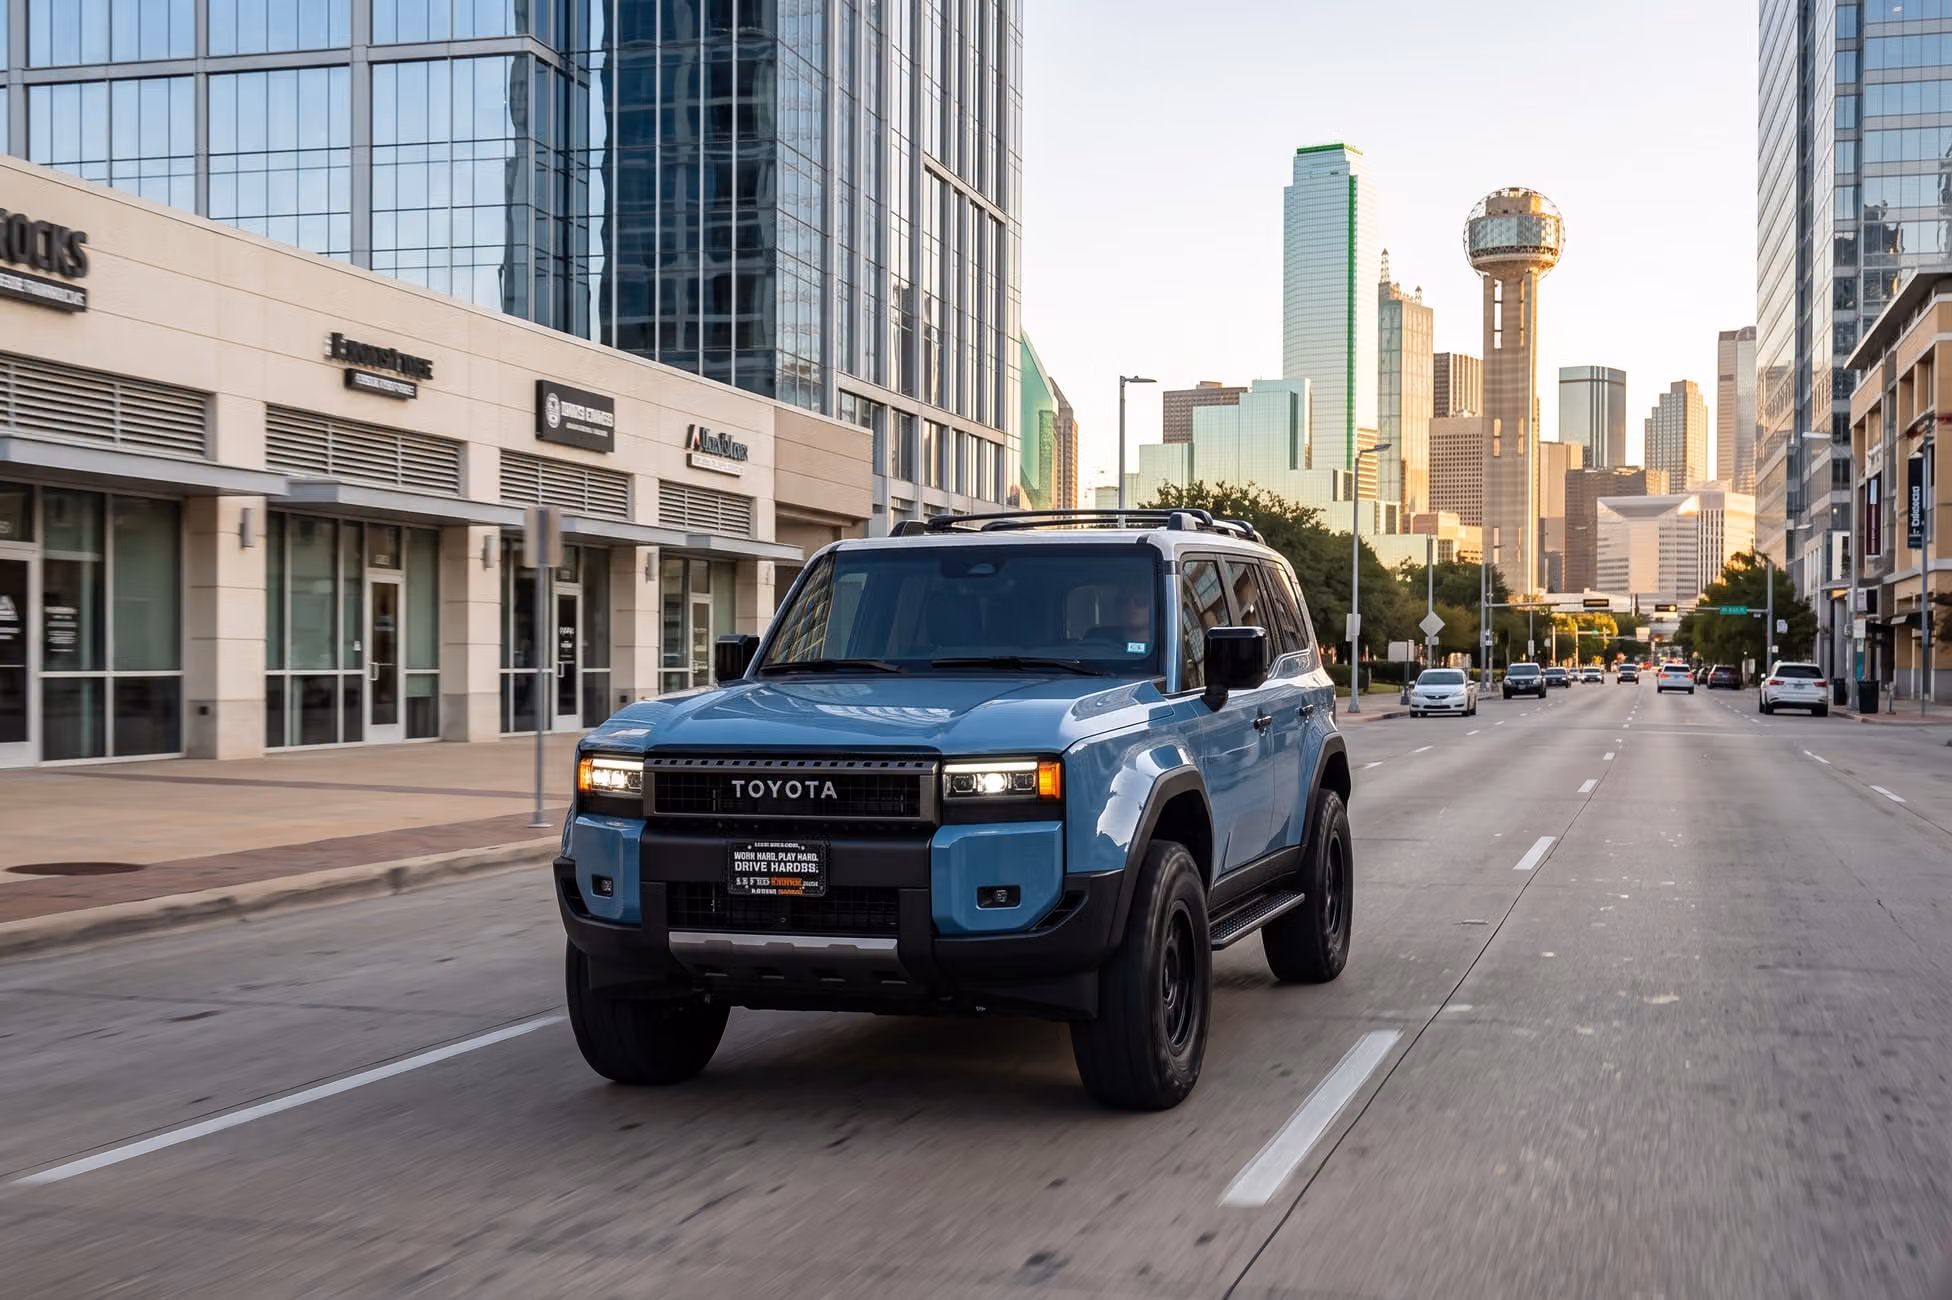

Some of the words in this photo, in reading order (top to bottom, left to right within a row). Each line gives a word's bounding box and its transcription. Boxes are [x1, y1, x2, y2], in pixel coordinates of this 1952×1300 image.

[731, 780, 838, 799] TOYOTA
[778, 852, 797, 862] PLAY
[734, 861, 768, 872] DRIVE
